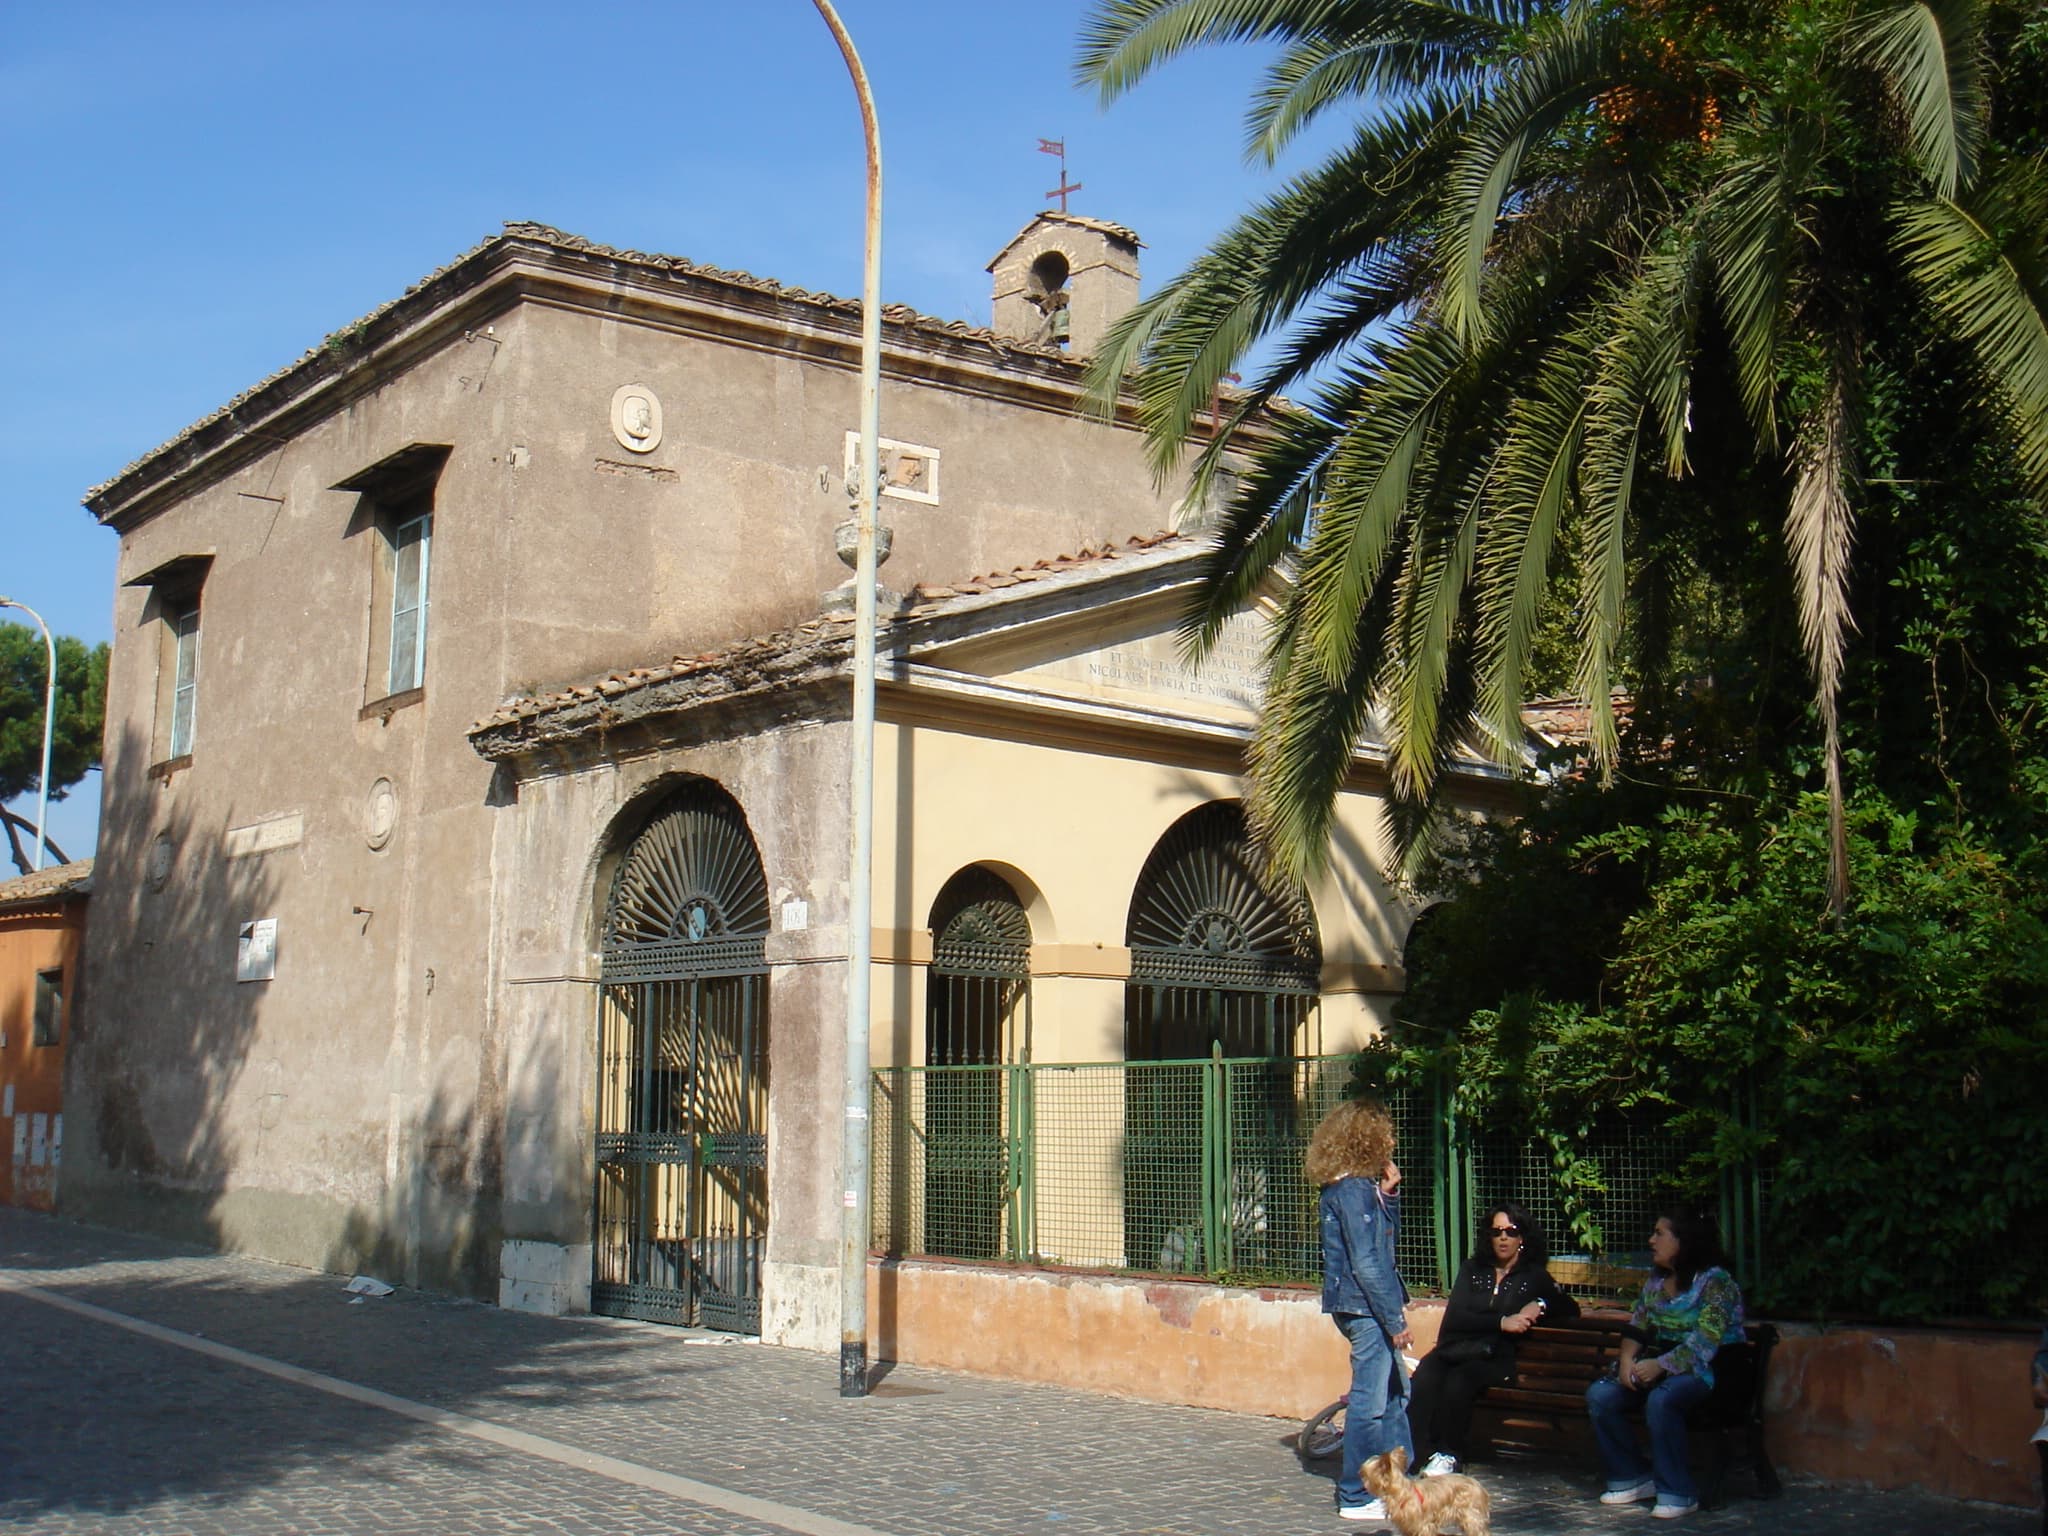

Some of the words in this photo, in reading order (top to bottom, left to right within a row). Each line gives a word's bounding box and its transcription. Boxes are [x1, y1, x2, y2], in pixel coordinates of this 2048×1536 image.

[1111, 652, 1121, 664] ET
[1089, 663, 1144, 682] NICOLAUS
[1190, 682, 1205, 694] DE
